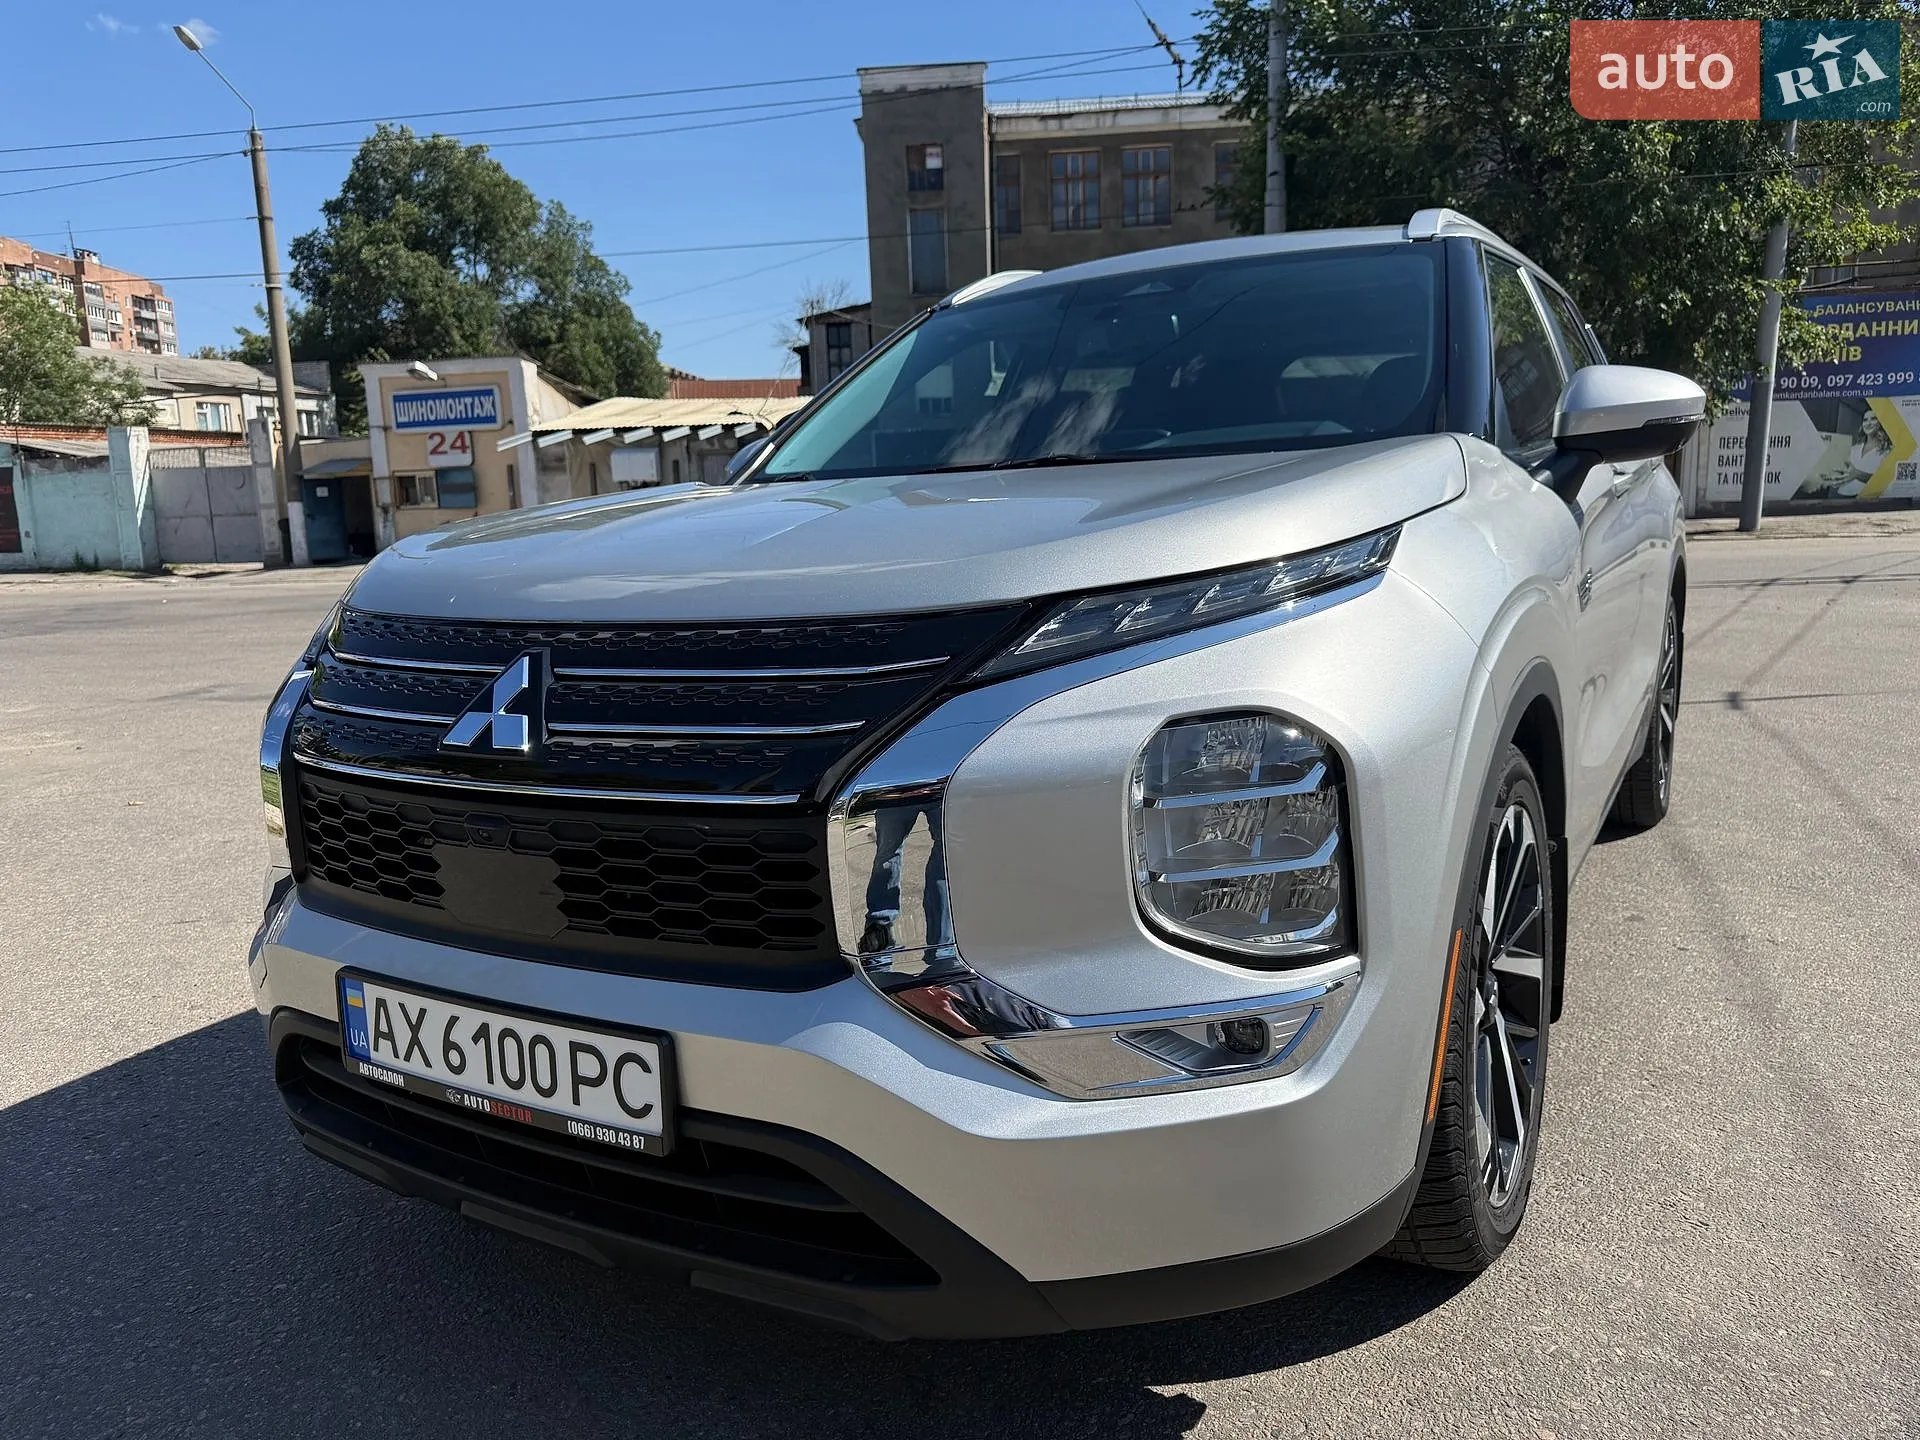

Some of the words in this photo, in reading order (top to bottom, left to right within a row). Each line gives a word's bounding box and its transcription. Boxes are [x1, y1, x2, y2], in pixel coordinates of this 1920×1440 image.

[1780, 376, 1797, 389] 90
[1801, 375, 1822, 390] 09,
[1827, 374, 1853, 388] 097
[1857, 373, 1883, 386] 423
[1887, 371, 1914, 385] 999
[395, 395, 496, 423] ШИНОМОНТАЖ
[427, 430, 470, 456] 24
[1717, 472, 1729, 486] ТА
[350, 1028, 368, 1049] UA
[372, 997, 433, 1069] AX
[442, 1015, 559, 1099] 6100
[568, 1040, 654, 1120] PC
[359, 1062, 405, 1087] АВТОСАЛОН
[463, 1093, 533, 1124] AUTOSECTOR
[567, 1120, 595, 1139] (066)
[596, 1126, 617, 1145] 930
[618, 1132, 632, 1148] 43
[632, 1135, 645, 1150] 87
